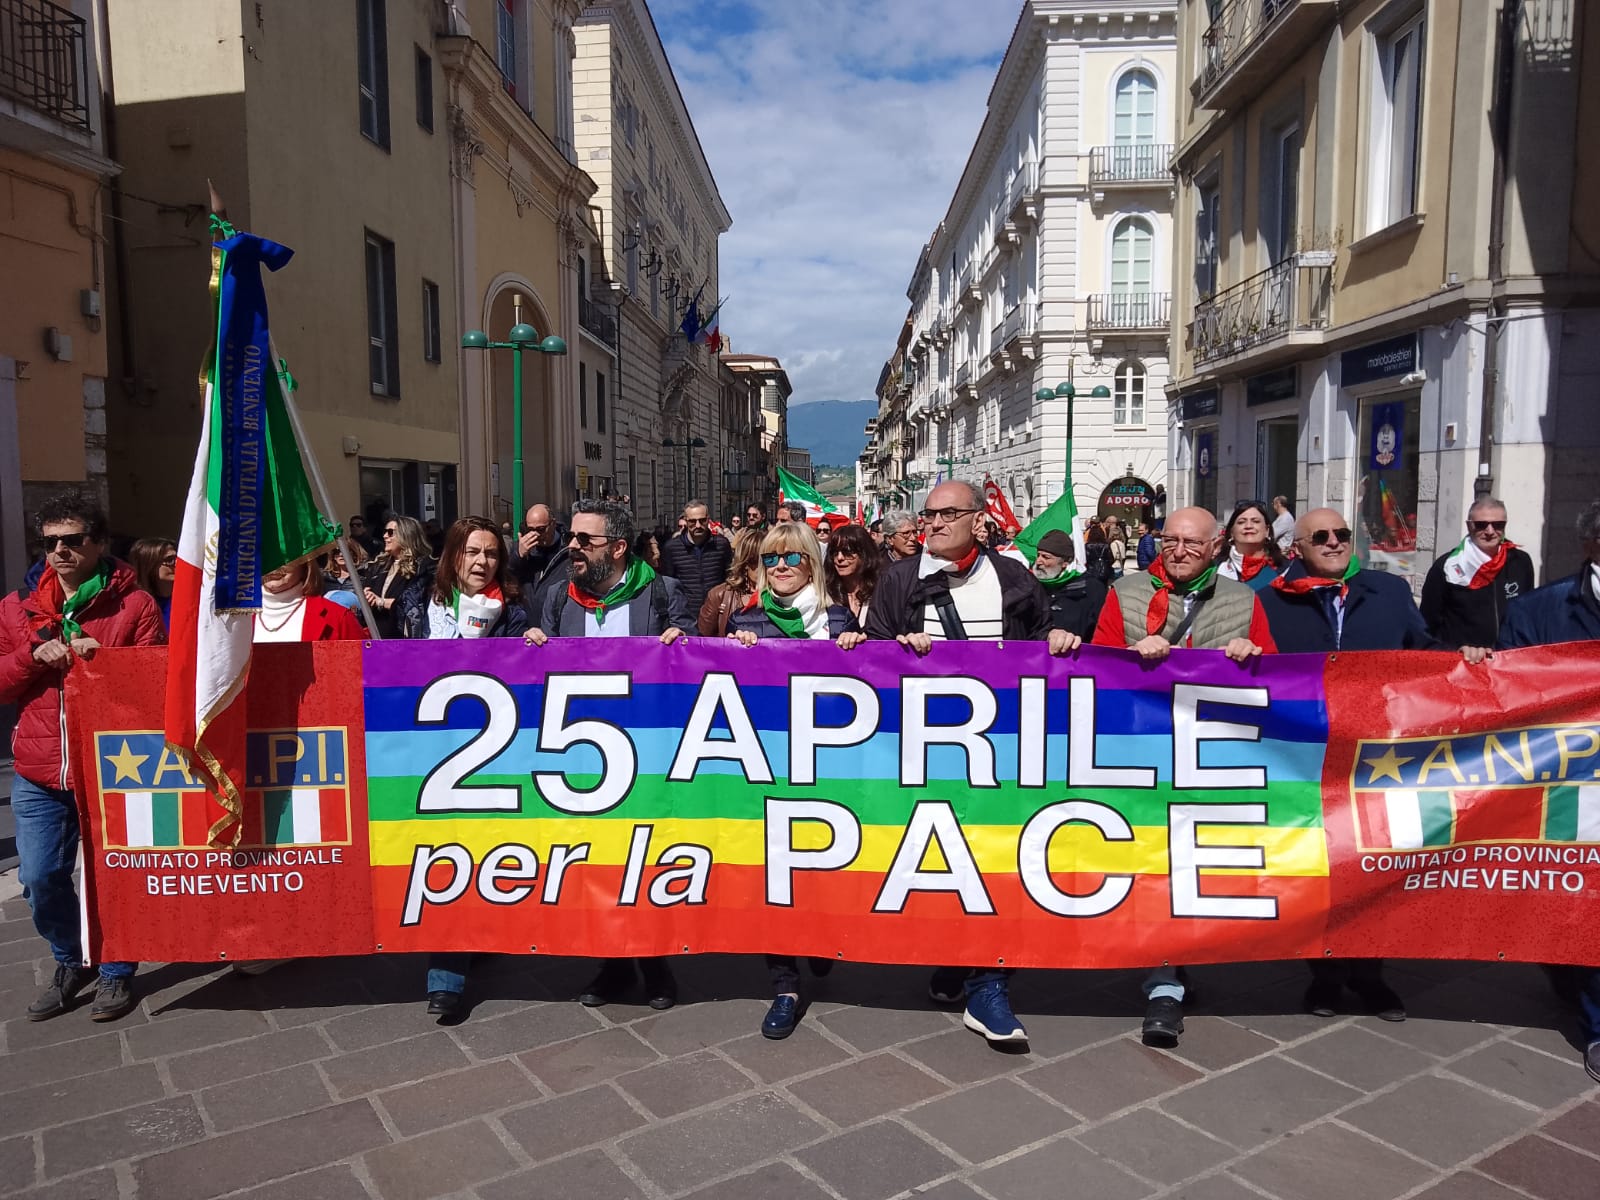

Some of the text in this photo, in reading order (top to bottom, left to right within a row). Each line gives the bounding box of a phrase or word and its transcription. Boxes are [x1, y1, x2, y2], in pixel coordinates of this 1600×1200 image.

[235, 344, 262, 602] PARTIGIANI D'ITALIA BENEVENTO
[1106, 496, 1149, 505] ADORO
[416, 671, 1270, 815] 25 APRILE
[105, 847, 343, 869] COMITATO PROVINCIALE
[400, 796, 1280, 928] per la PACE
[1360, 848, 1467, 873] COMITATO
[146, 871, 304, 896] BENEVENTO
[1403, 868, 1585, 893] BENEVENTO
